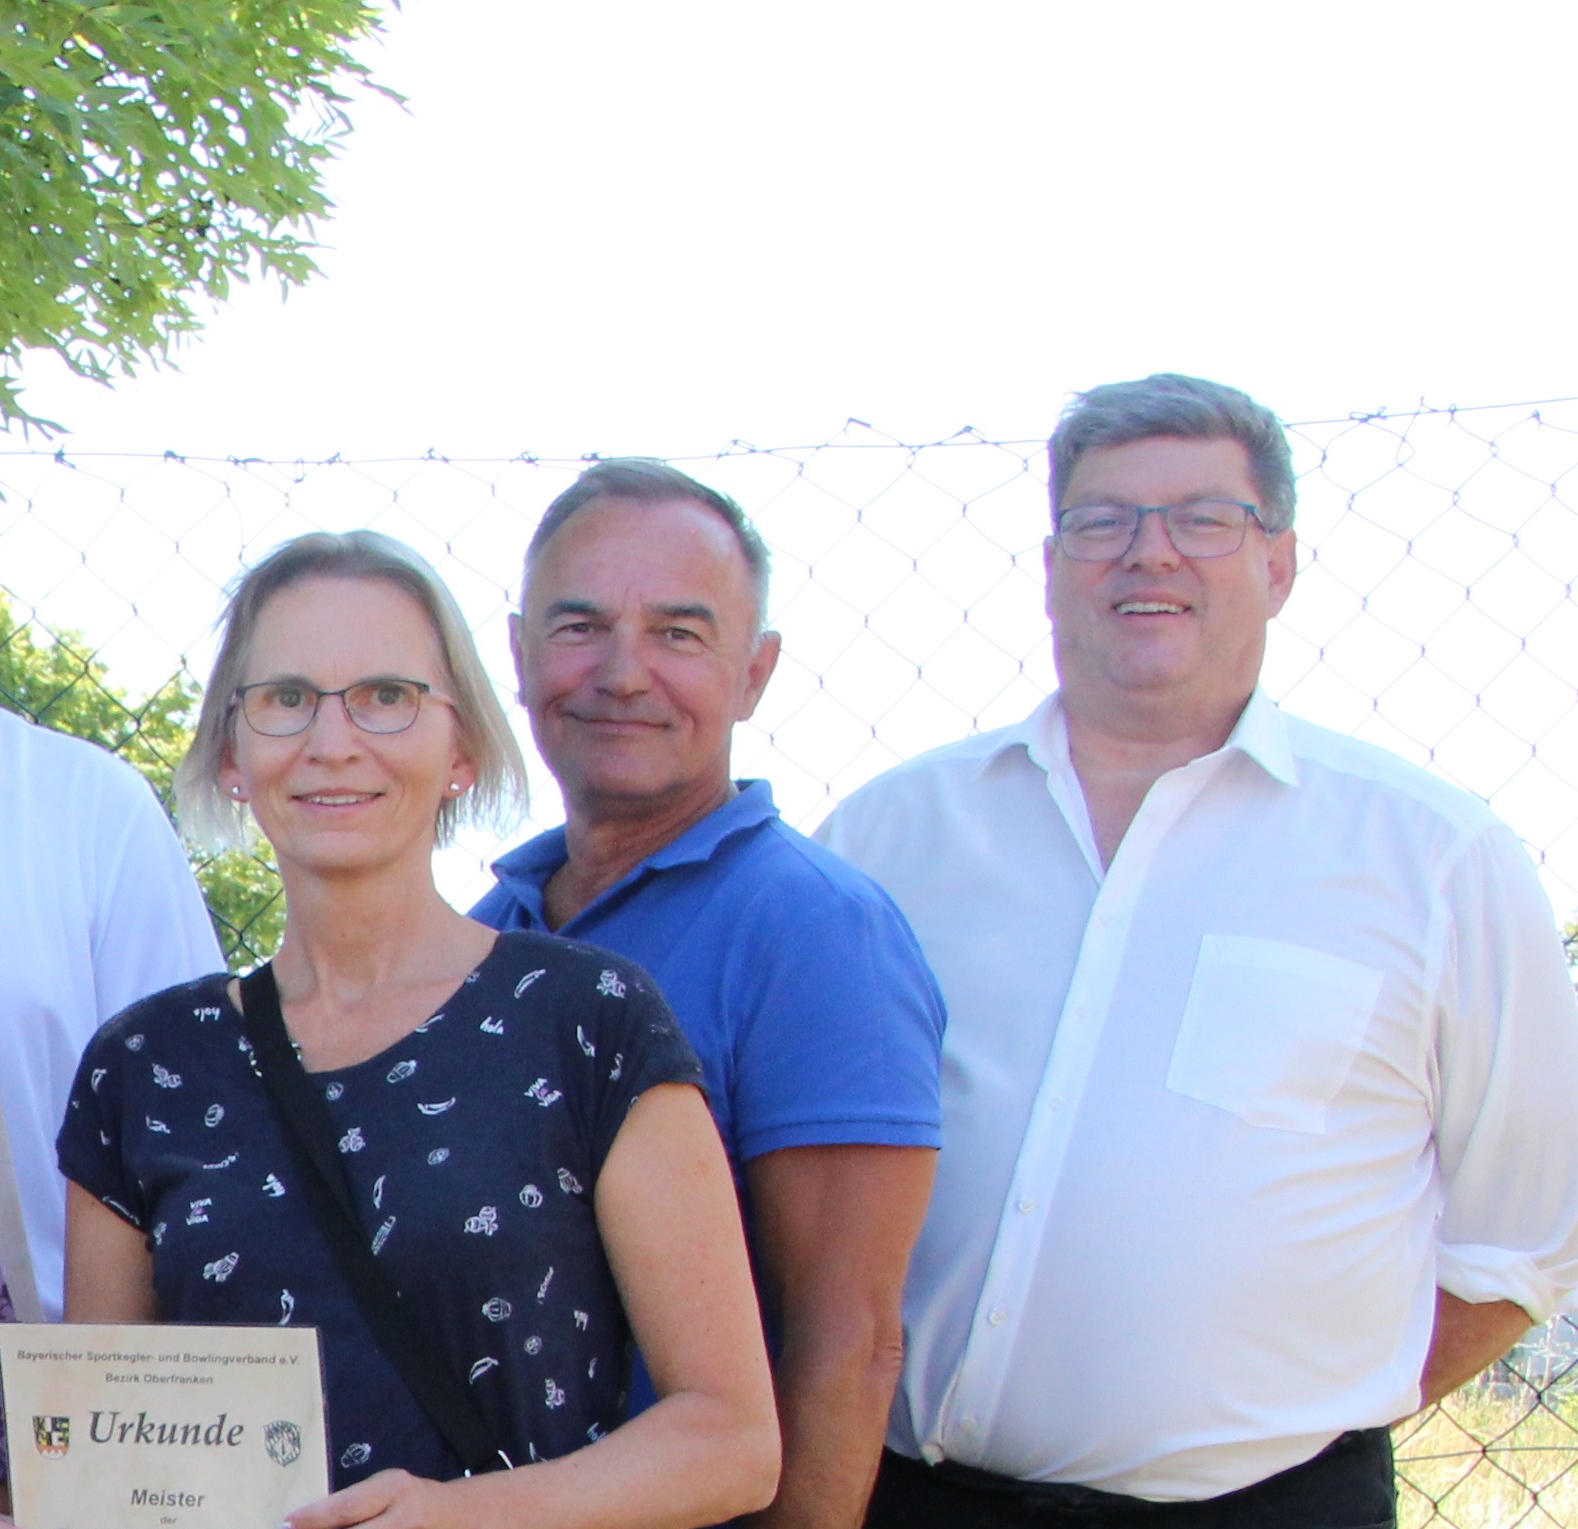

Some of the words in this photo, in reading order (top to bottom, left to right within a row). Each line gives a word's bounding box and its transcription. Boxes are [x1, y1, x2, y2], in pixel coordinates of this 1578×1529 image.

[17, 1350, 83, 1363] Bayerischer
[158, 1353, 179, 1363] und
[183, 1353, 277, 1367] Bowlingverband
[279, 1355, 300, 1365] e.V.
[106, 1373, 140, 1384] Bezirk
[144, 1374, 213, 1385] Oberfranken
[88, 1410, 244, 1447] Urkunde
[131, 1489, 205, 1508] Meister
[160, 1516, 177, 1525] der
